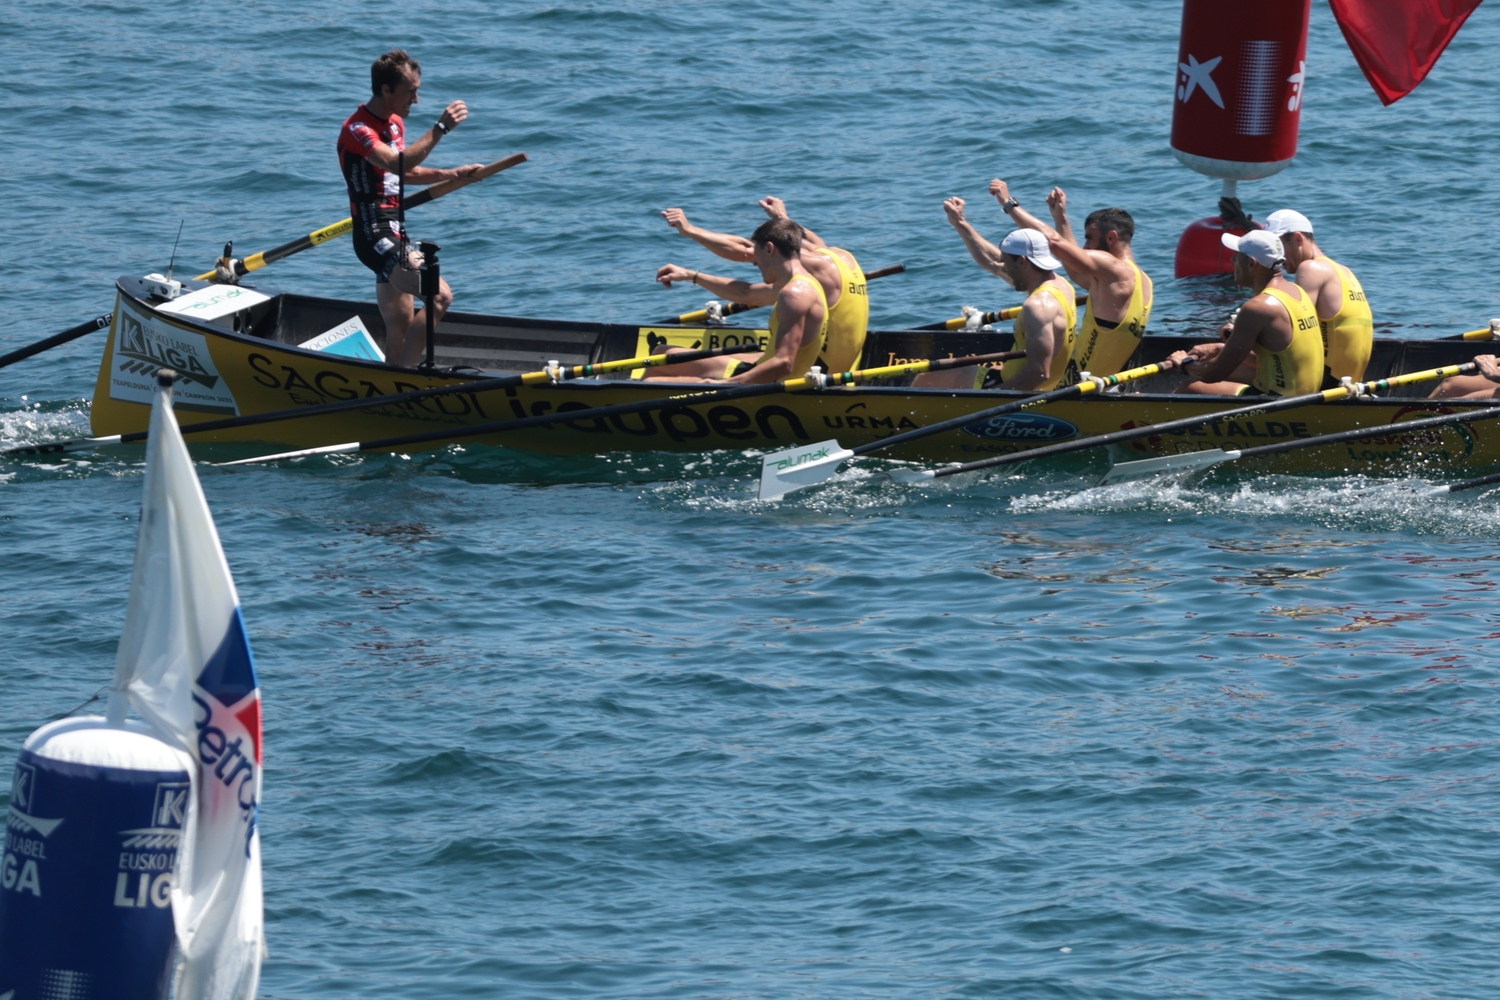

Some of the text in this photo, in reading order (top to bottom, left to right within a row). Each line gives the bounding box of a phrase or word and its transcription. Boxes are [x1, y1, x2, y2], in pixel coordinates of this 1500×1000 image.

[143, 325, 200, 357] EUSKO LABEL
[305, 322, 359, 351] OCIONES
[146, 339, 210, 376] LIGA
[248, 353, 488, 420] SAGARDI
[822, 415, 920, 430] URMA
[984, 416, 1057, 439] Ford
[766, 447, 830, 470] alumak
[13, 837, 47, 860] LABEL
[118, 852, 167, 870] EUSKO
